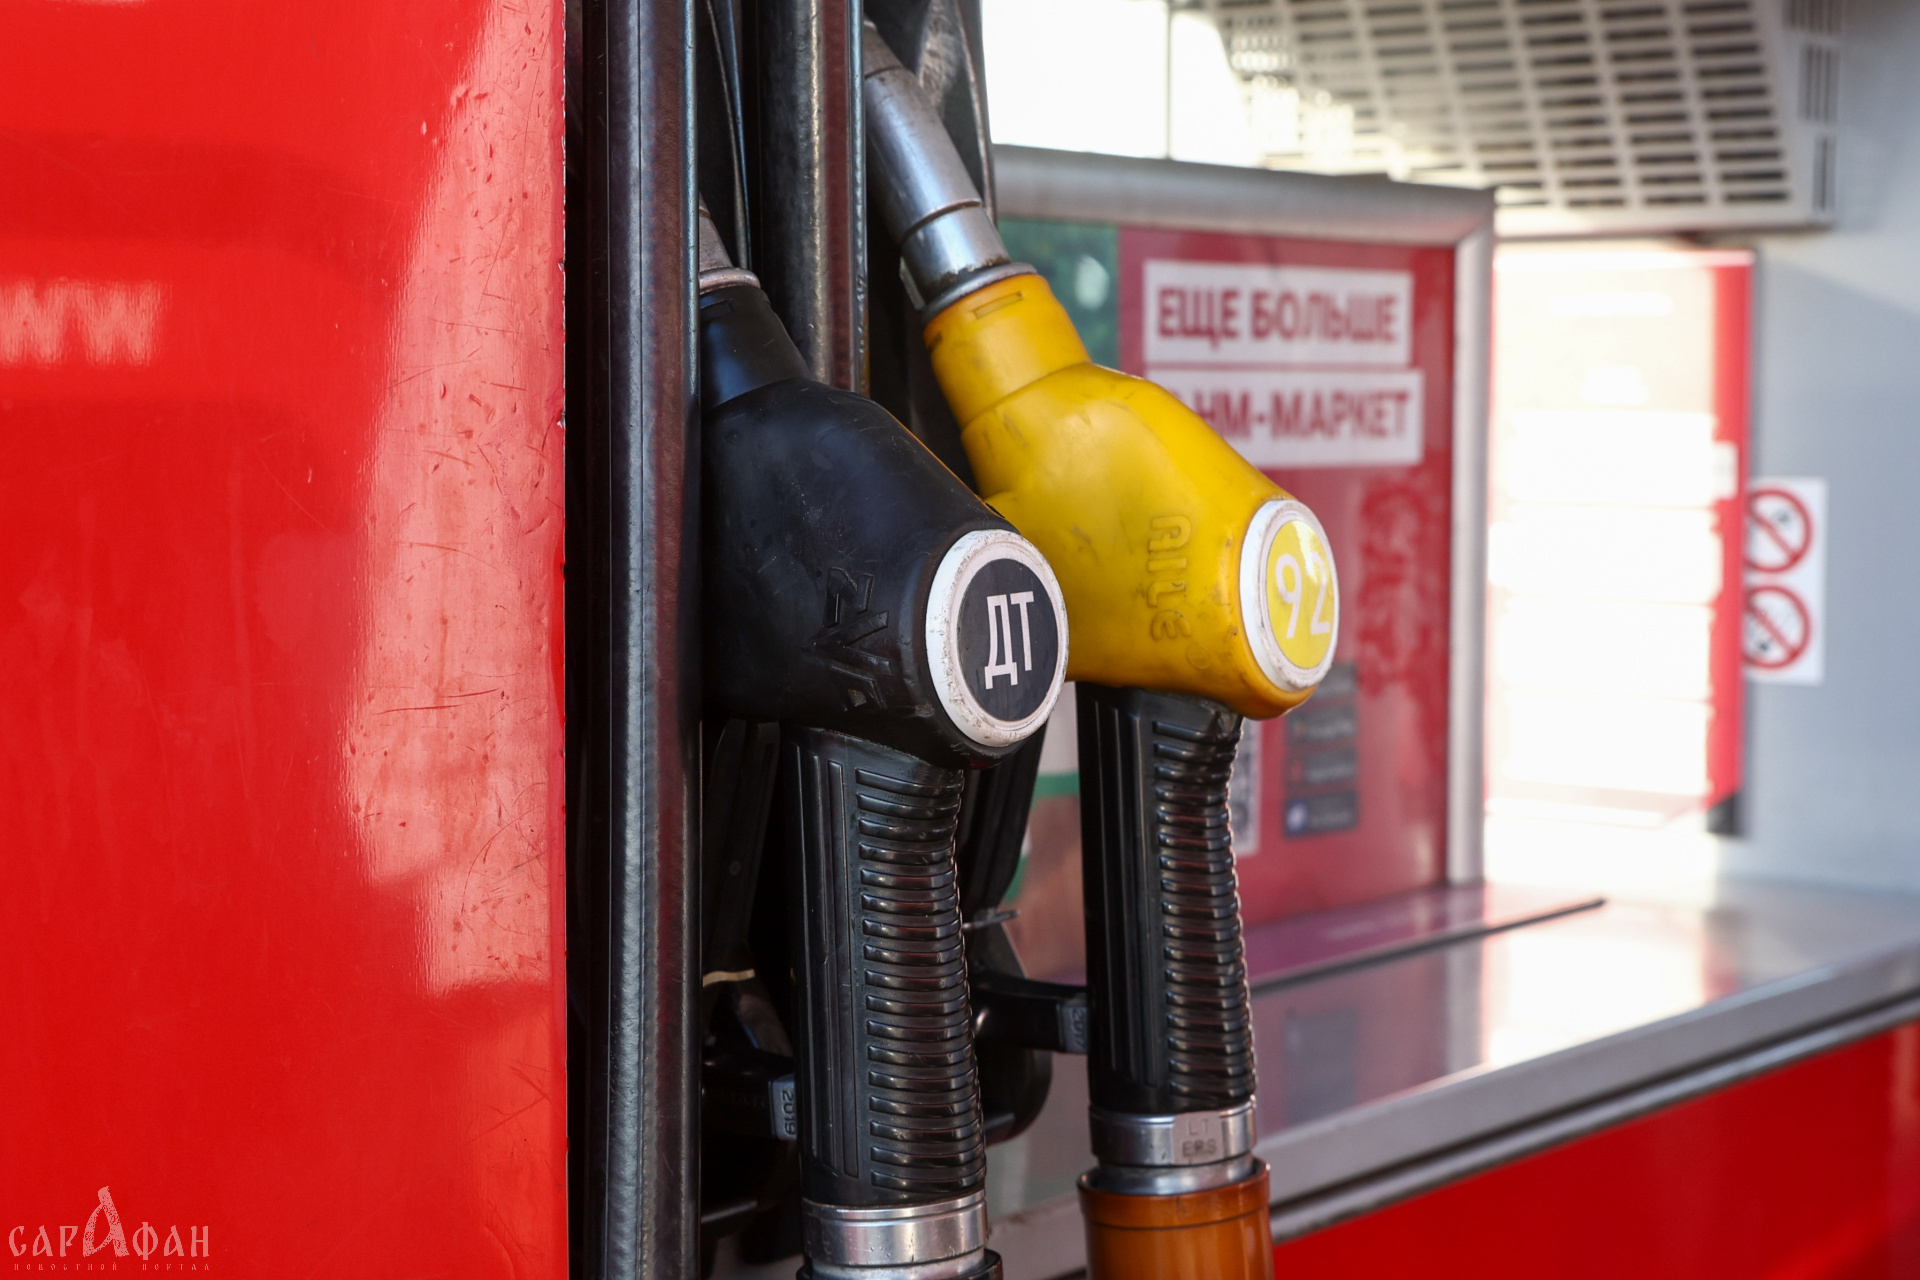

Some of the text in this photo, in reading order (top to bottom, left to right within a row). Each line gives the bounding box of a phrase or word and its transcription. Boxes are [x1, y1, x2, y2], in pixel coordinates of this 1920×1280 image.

[1157, 285, 1397, 351] ЕЩЕ БОЛЬШЕ
[1274, 550, 1331, 640] 92
[984, 590, 1035, 690] ДТ
[781, 1089, 796, 1136] 2019
